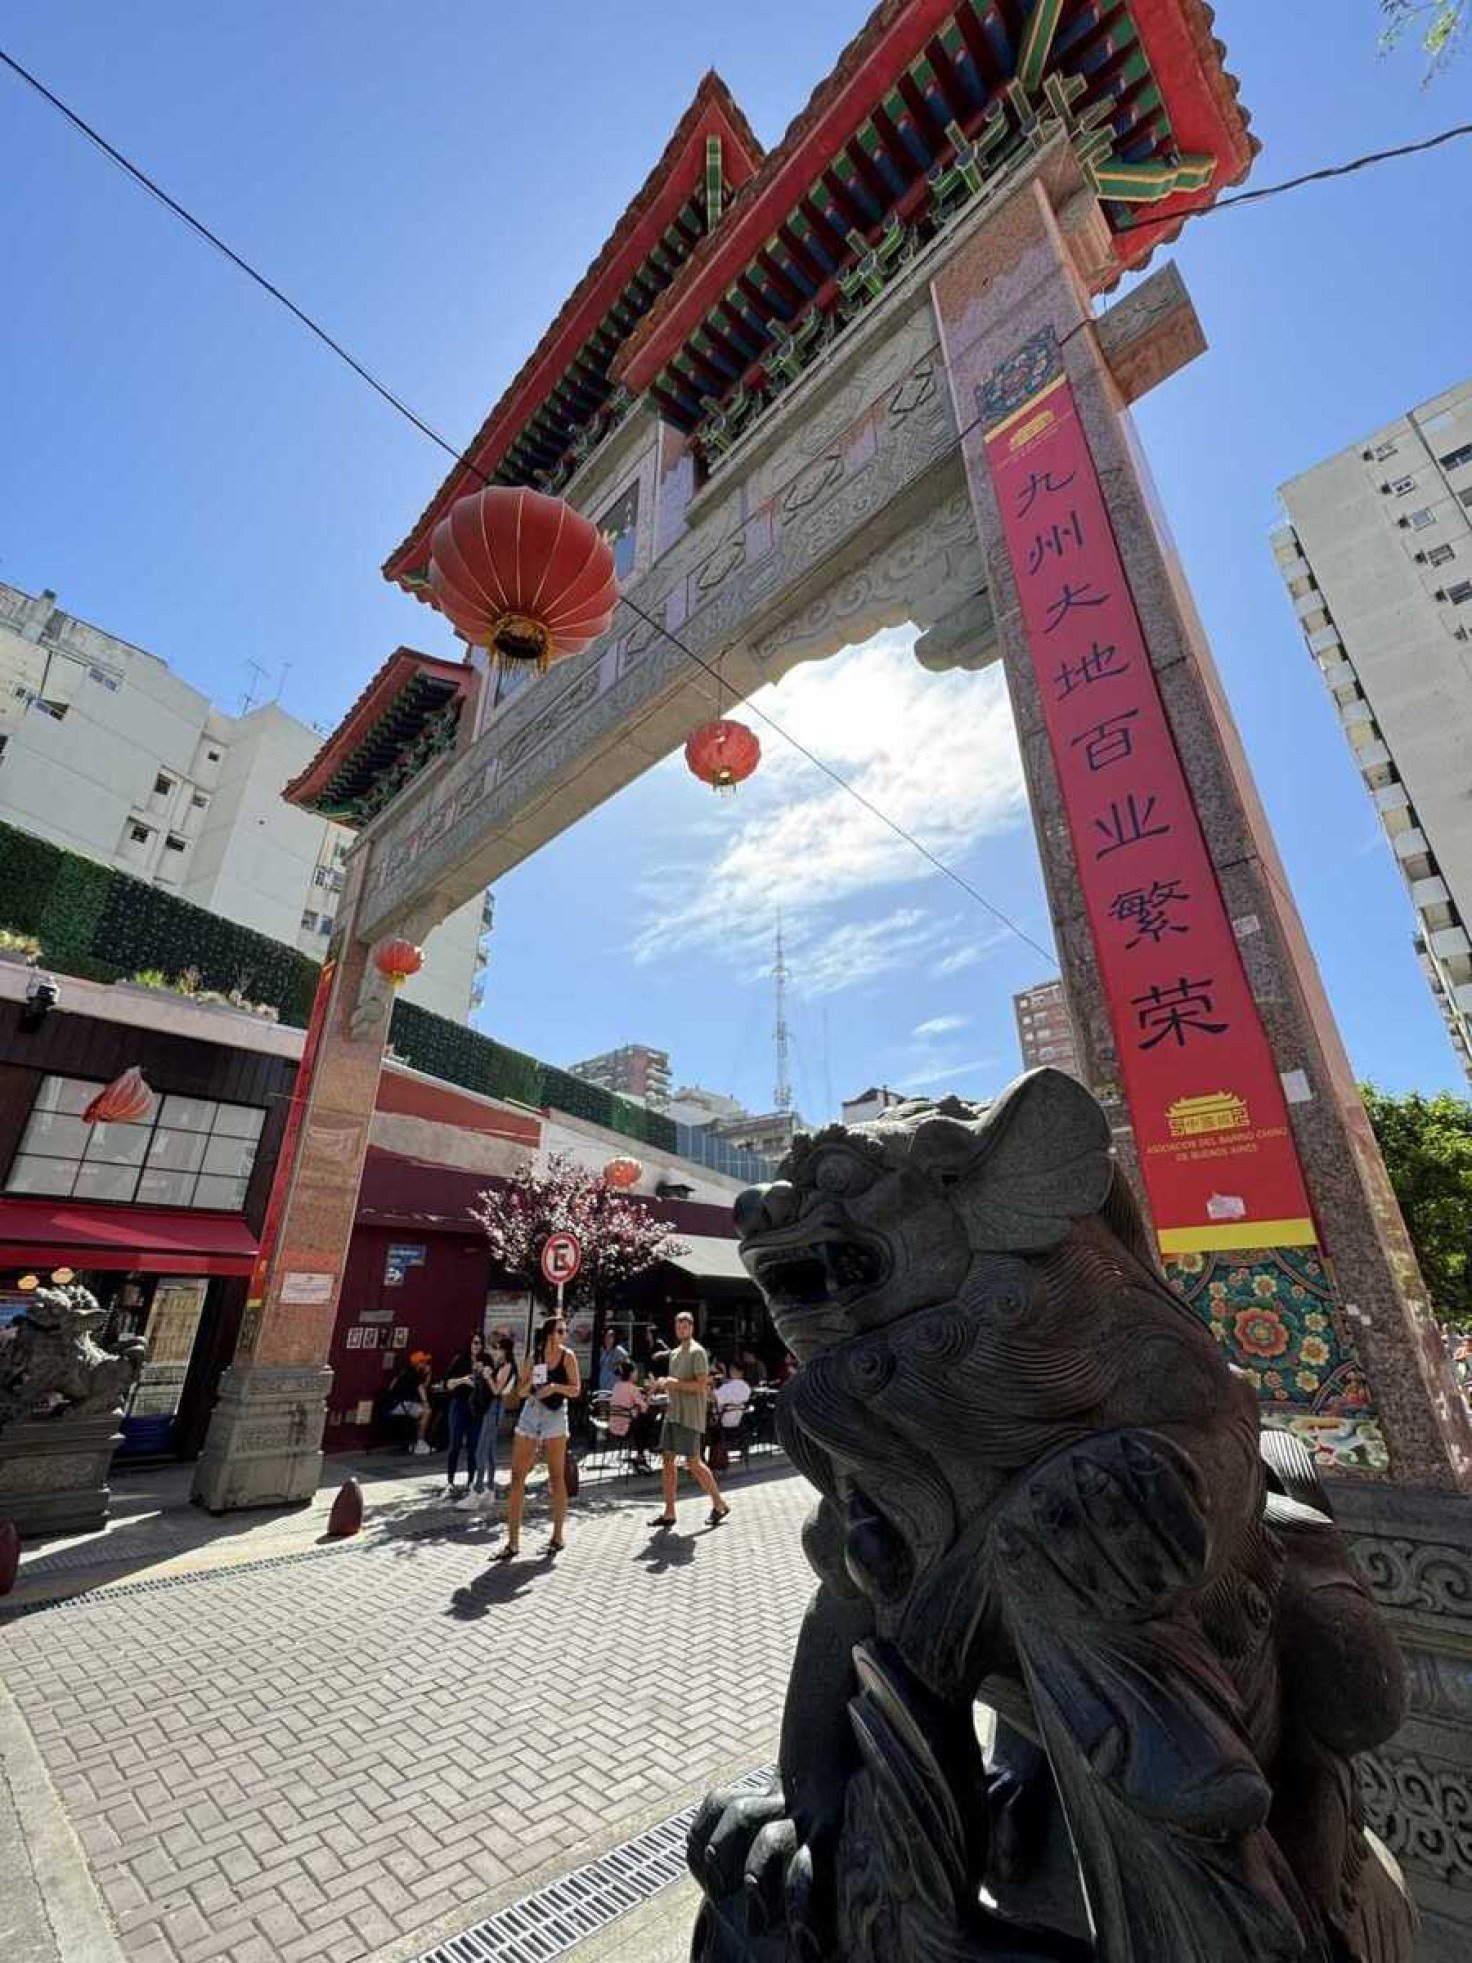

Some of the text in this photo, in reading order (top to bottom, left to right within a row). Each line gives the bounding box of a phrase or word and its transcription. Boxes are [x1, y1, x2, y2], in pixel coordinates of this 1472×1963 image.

[1016, 470, 1228, 1051] 九州大地百业繁荣
[553, 1243, 569, 1271] E
